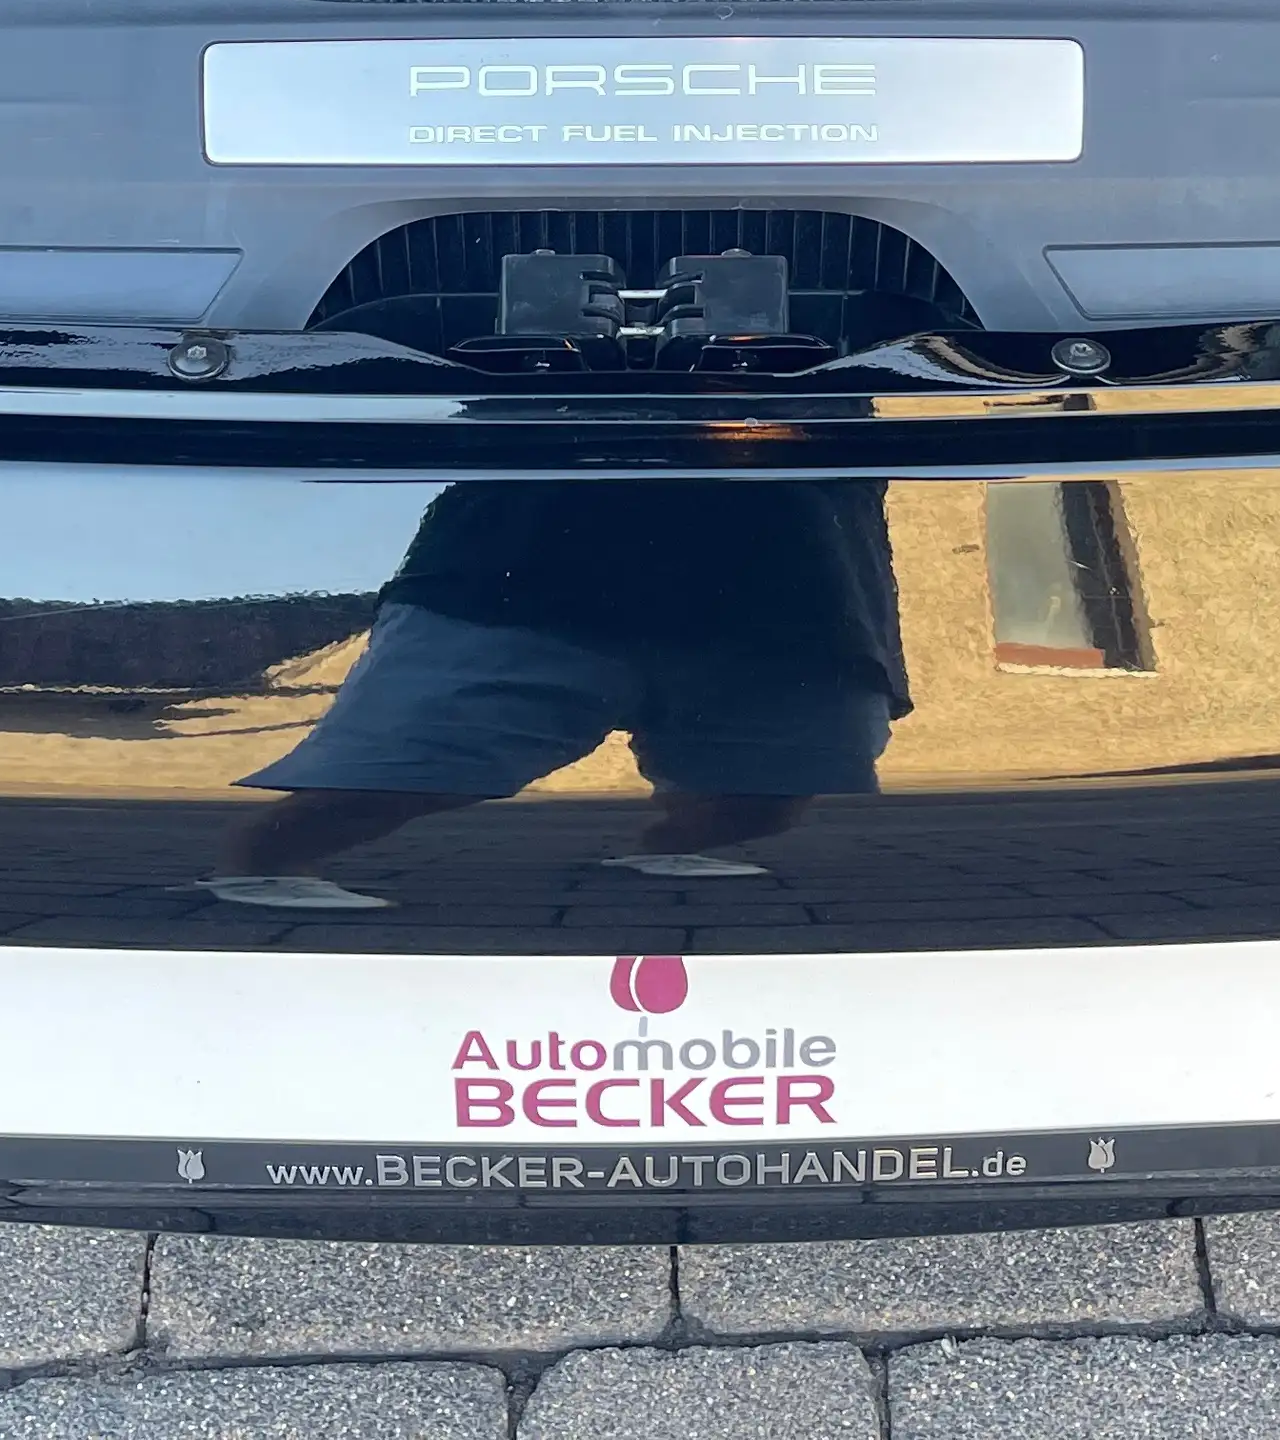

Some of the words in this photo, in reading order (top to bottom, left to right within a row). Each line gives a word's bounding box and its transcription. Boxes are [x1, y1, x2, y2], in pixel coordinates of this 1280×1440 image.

[408, 62, 877, 98] PORSCHE
[408, 123, 547, 146] DIRECT
[561, 123, 659, 144] FUEL
[672, 122, 879, 144] INJECTION
[450, 1027, 838, 1072] Automobile
[453, 1074, 838, 1129] BECKER
[265, 1146, 1028, 1190] www.BECKER-AUTOHANDEL.de
